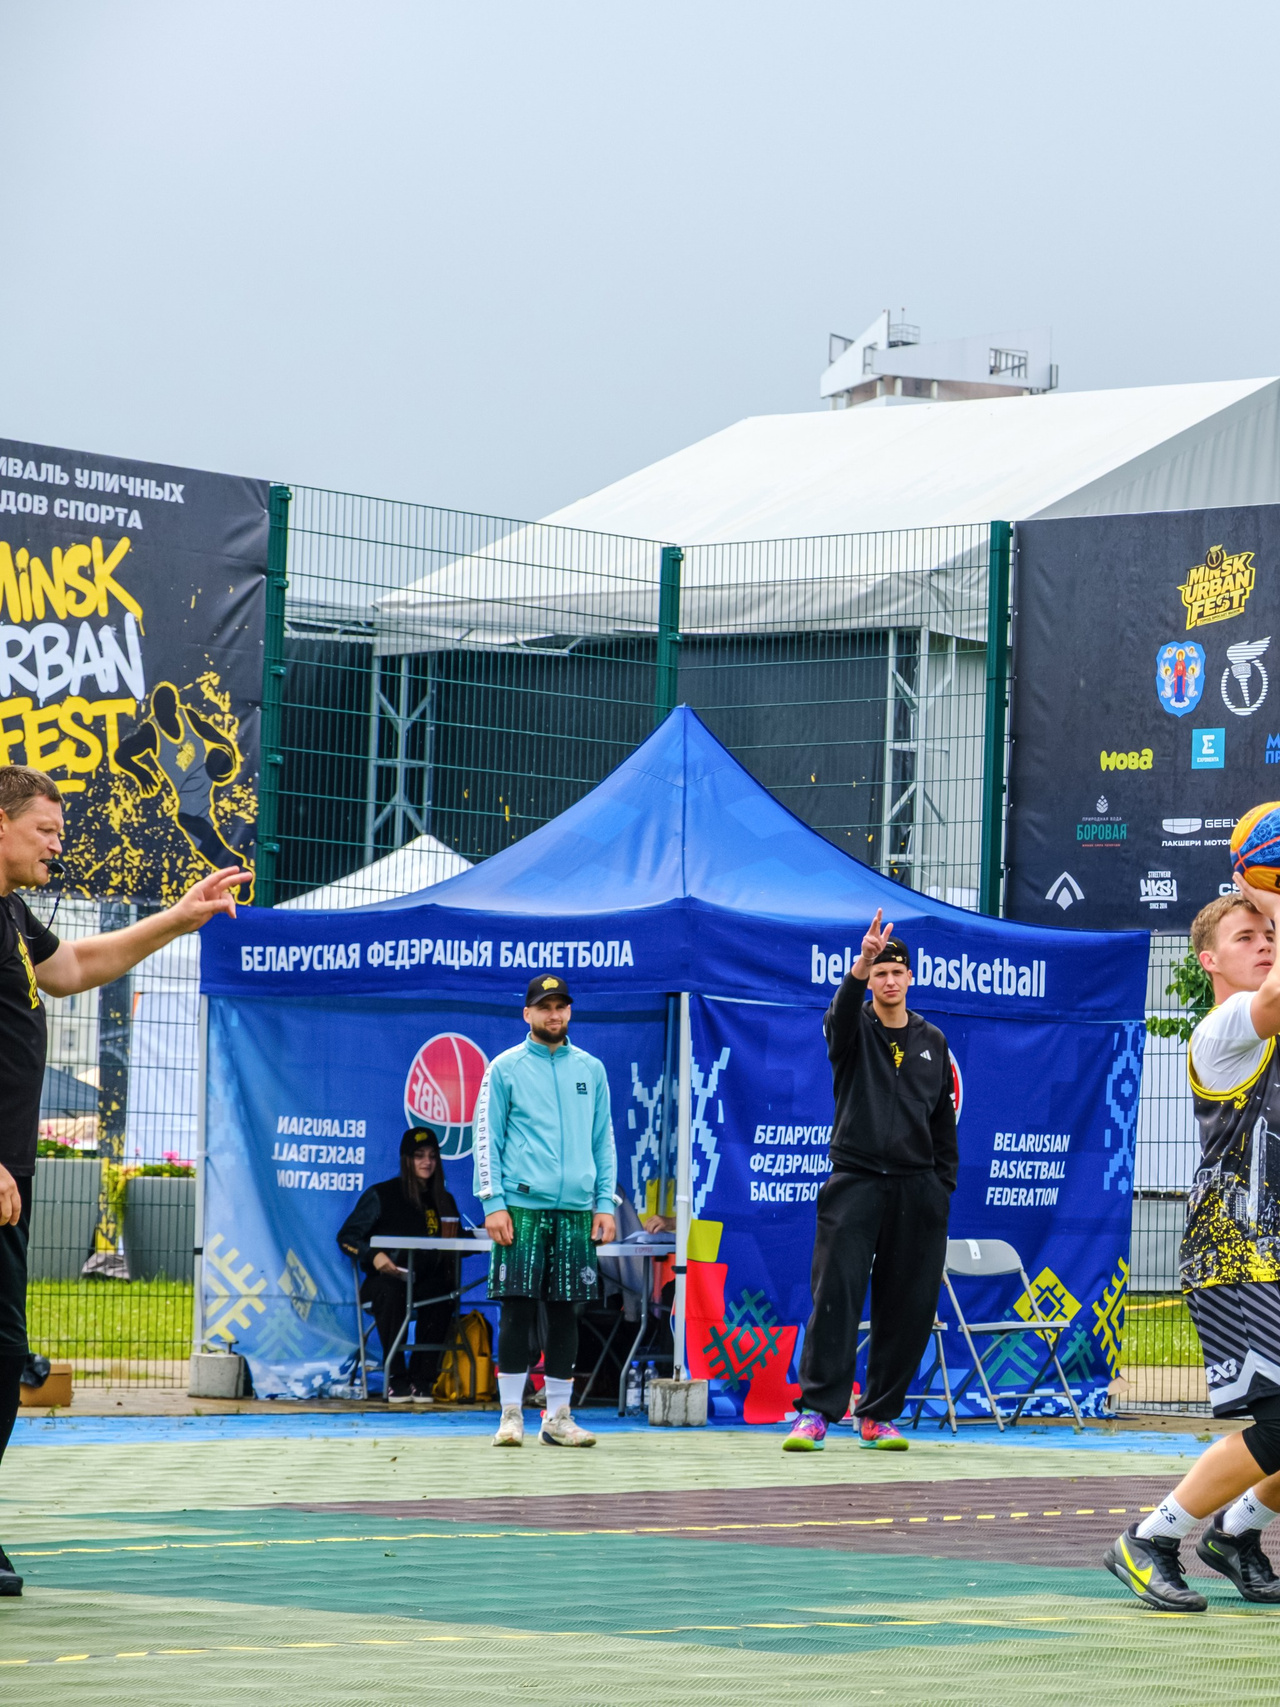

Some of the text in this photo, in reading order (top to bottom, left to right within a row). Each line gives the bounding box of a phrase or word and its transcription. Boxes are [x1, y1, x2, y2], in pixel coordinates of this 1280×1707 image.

[0, 456, 185, 504] ИВАЛЬ УЛИЧНЫХ
[0, 489, 143, 530] ДОВ СПОРТА
[1188, 554, 1249, 586] MINSK
[1184, 569, 1251, 604] URBAN
[1190, 587, 1245, 624] FEST
[0, 612, 146, 708] RBAN
[1076, 823, 1127, 841] БОРОВАЯ
[241, 938, 635, 972] БЕЛАРУСКАЯ ФЕДЭРАЦЫЯ БАСКЕТБОЛА
[754, 1125, 834, 1146] БЕЛАРУСКА
[993, 1132, 1071, 1153] BELARUSIAN
[989, 1159, 1066, 1180] BASKETBALL
[750, 1181, 825, 1202] БАСКЕТБО
[985, 1186, 1059, 1206] FEDERATION
